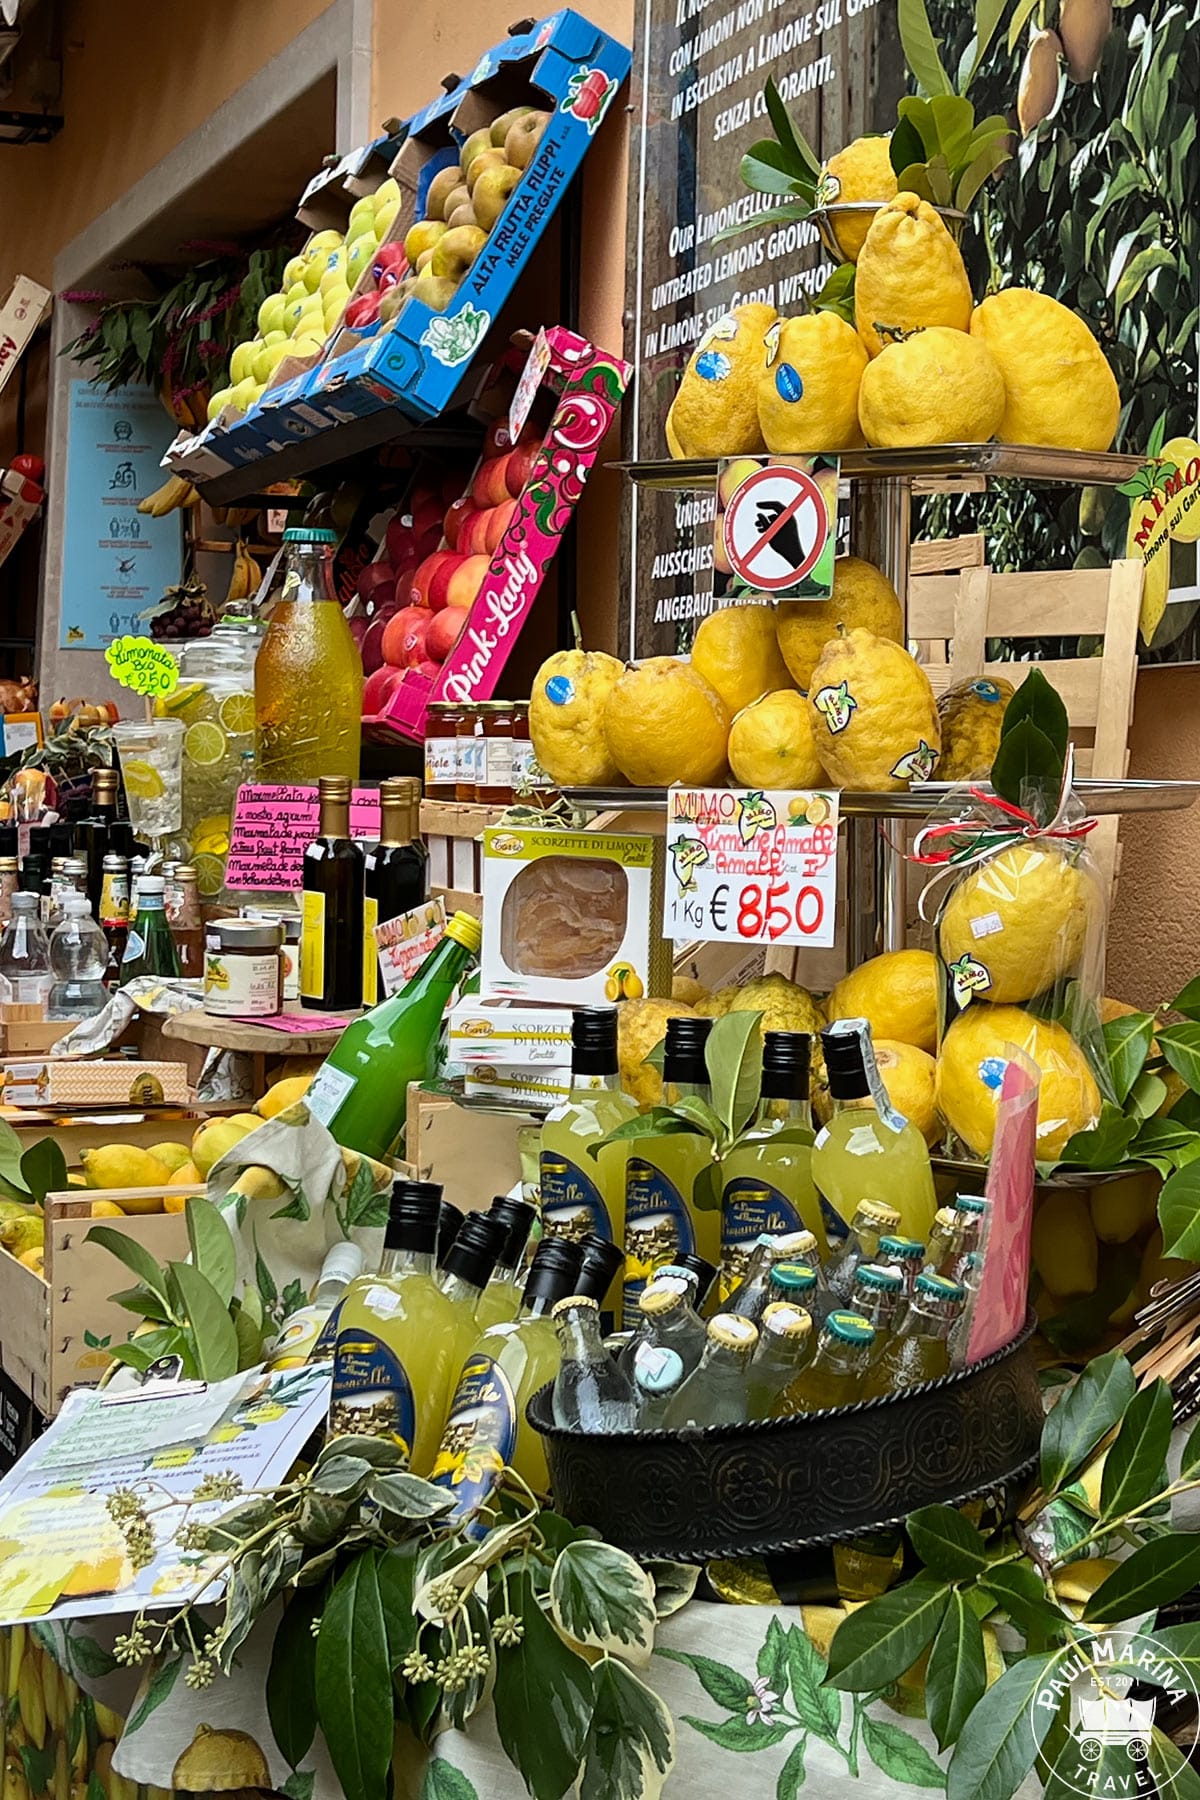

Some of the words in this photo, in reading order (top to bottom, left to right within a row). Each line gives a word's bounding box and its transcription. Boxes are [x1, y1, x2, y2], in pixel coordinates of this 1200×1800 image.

[669, 40, 693, 77] CON
[692, 10, 735, 61] LIMONI
[736, 0, 764, 33] NON
[671, 90, 684, 121] IN
[684, 54, 743, 112] ESCLUSIVA
[745, 47, 754, 75] A
[757, 16, 812, 68] LIMONE
[814, 1, 842, 36] SUL
[713, 100, 750, 141] SENZA
[753, 54, 835, 118] COORANTI.
[471, 253, 502, 296] ALTA
[494, 194, 531, 252] FRUTTA
[528, 138, 561, 193] FILIPPI
[506, 233, 531, 270] MELE
[526, 167, 565, 233] PREGIATE
[669, 224, 695, 258] OUR
[652, 263, 712, 311] UNTREATED
[714, 238, 764, 284] LEMONS
[768, 220, 820, 264] GROWN
[645, 333, 657, 358] IN
[659, 312, 704, 352] LIMONE
[676, 497, 716, 529] UNBEH
[1134, 456, 1200, 550] MIMO
[651, 544, 713, 580] AUSSCHIES
[1143, 528, 1170, 568] imone
[1169, 509, 1184, 532] sul
[654, 591, 713, 623] ANGEBAUT
[108, 640, 175, 670] Limonata
[442, 628, 499, 703] Pink
[674, 792, 735, 818] MIMO
[531, 837, 590, 850] SCORZETTE
[591, 840, 604, 850] DI
[606, 840, 648, 852] LIMONE
[671, 901, 678, 922] 1
[684, 900, 704, 928] Kg
[710, 884, 730, 932] €
